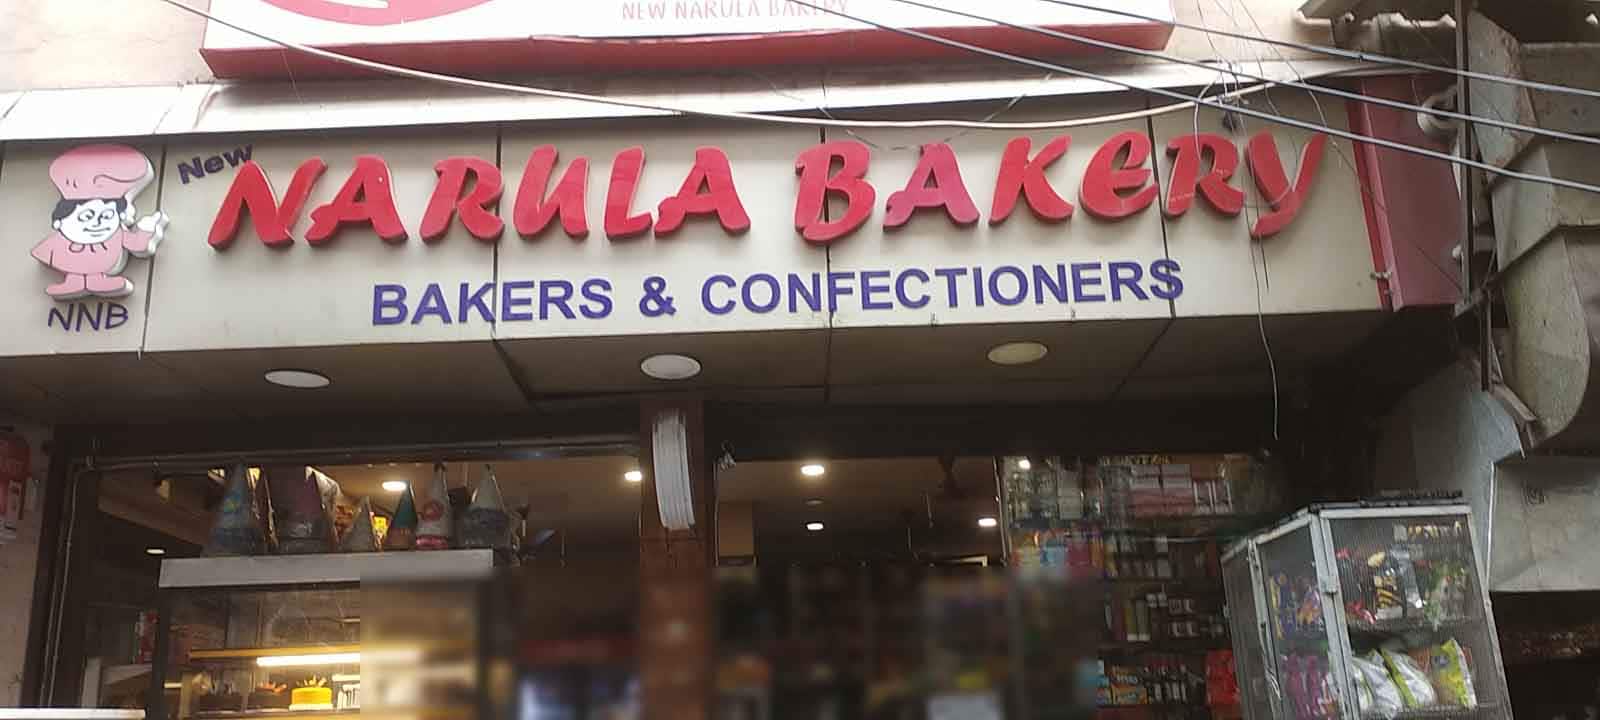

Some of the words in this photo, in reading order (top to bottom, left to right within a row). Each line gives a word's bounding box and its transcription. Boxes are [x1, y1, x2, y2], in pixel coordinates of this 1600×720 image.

[622, 1, 666, 20] NEW
[675, 0, 761, 19] NARULA
[178, 145, 253, 185] New
[207, 145, 751, 251] NARULA
[795, 130, 1328, 246] BAKERY
[371, 280, 614, 326] BAKERS
[638, 276, 677, 317] &
[700, 259, 1185, 316] CONFECTIONERS
[48, 302, 129, 332] NNB
